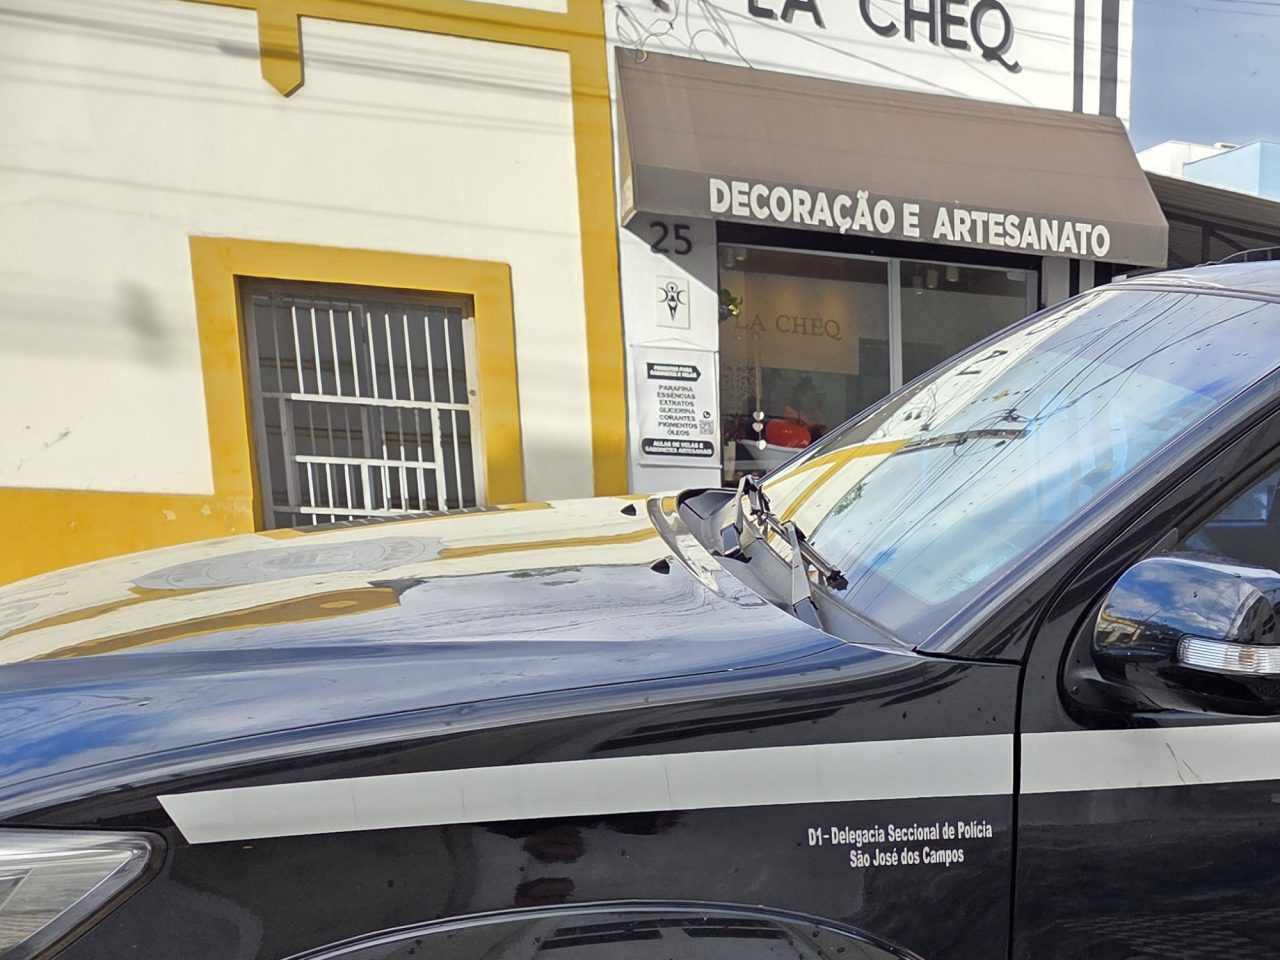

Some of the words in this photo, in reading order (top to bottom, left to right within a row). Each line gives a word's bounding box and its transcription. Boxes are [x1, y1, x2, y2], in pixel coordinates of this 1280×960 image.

[859, 0, 1022, 73] CHEQ
[709, 178, 896, 234] DECORAÇÃO
[903, 203, 920, 238] E
[933, 207, 1111, 257] ARTESANATO
[650, 222, 692, 255] 25
[735, 314, 767, 332] LA
[775, 315, 842, 341] CHEQ
[831, 825, 885, 847] Delegacia
[888, 823, 940, 841] Seccional
[942, 822, 955, 839] de
[957, 820, 993, 838] Polícia
[850, 850, 870, 867] São
[873, 848, 898, 866] José
[901, 848, 920, 864] dos
[922, 846, 964, 867] Campos
